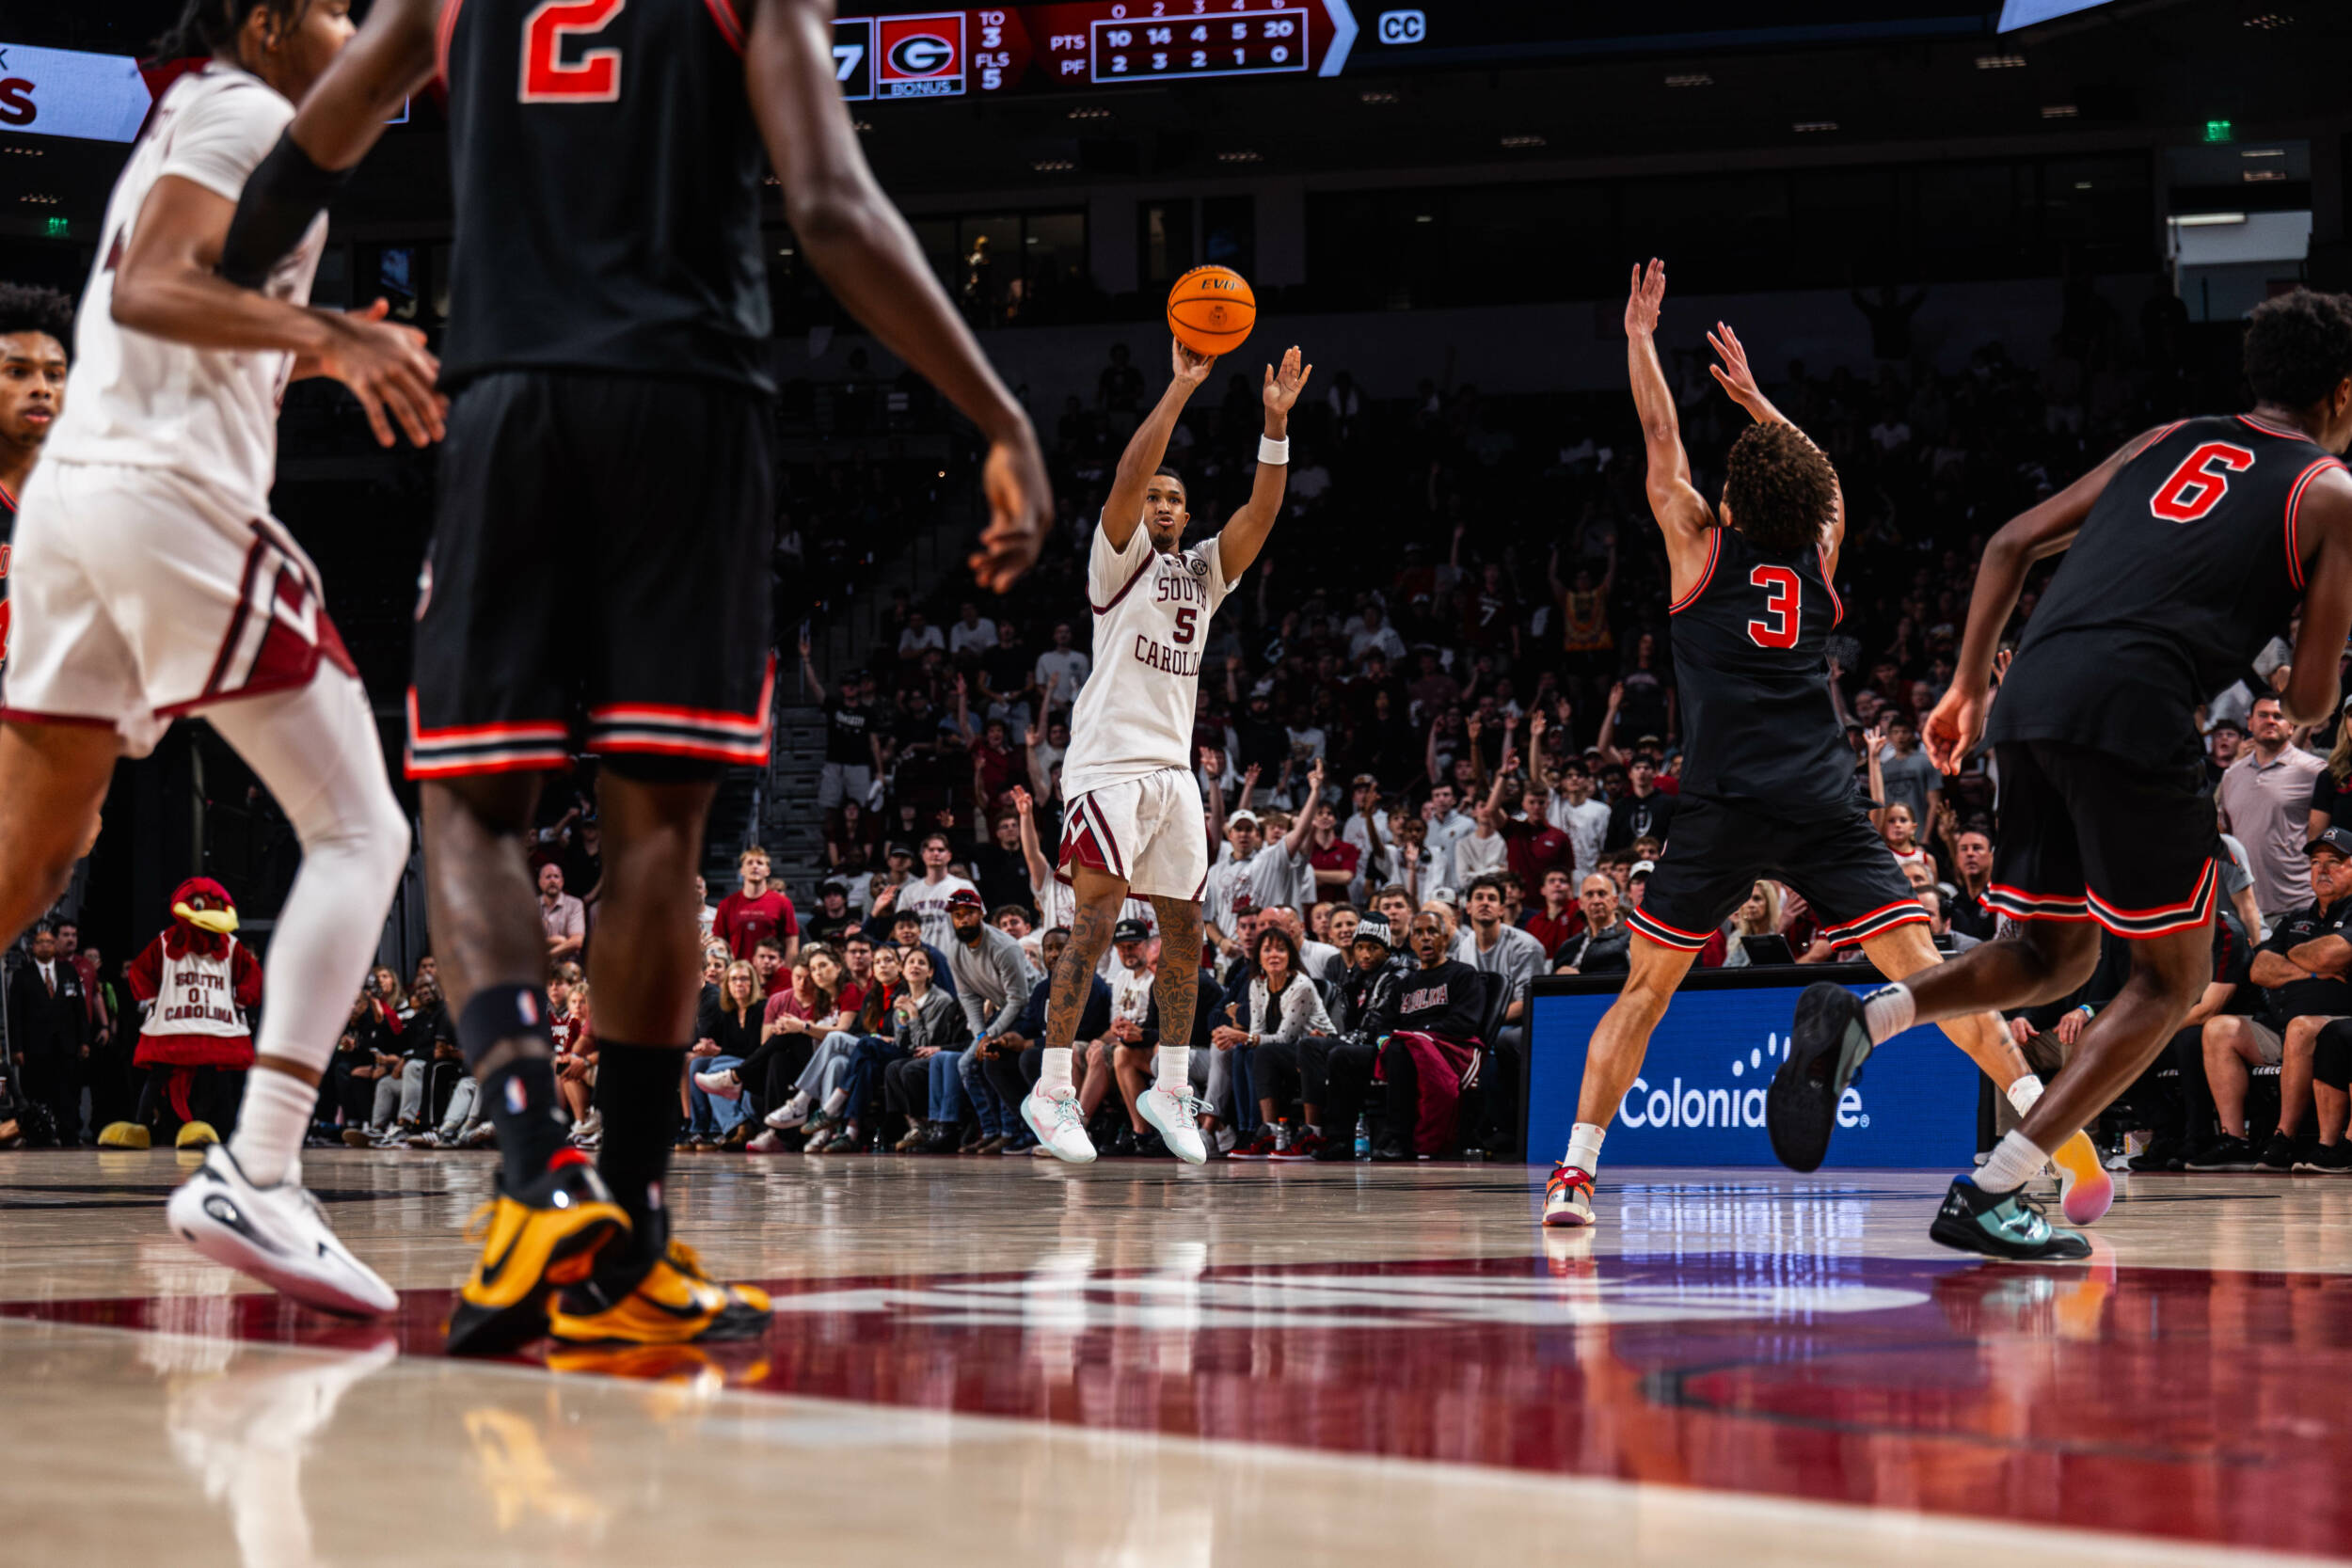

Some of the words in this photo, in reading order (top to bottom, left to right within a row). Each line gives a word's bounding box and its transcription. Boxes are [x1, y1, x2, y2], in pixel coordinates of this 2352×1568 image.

[977, 11, 1005, 25] TO
[1111, 4, 1126, 19] 0
[1151, 2, 1165, 17] 2
[1192, 0, 1205, 14] 3
[981, 26, 1001, 48] 3
[1050, 35, 1086, 52] PTS
[1107, 30, 1132, 47] 10
[1146, 27, 1173, 45] 14
[1191, 25, 1207, 42] 4
[1232, 24, 1248, 40] 5
[1263, 21, 1294, 38] 20
[1384, 16, 1424, 40] CC
[517, 0, 625, 103] 2
[833, 44, 864, 81] 7
[976, 52, 1009, 69] FLS
[1061, 60, 1086, 76] PF
[1112, 55, 1128, 72] 2
[1152, 53, 1168, 70] 3
[1191, 51, 1207, 68] 2
[1233, 48, 1246, 65] 1
[1271, 45, 1288, 63] 0
[892, 81, 952, 97] BONUS
[981, 69, 1001, 90] 5
[2150, 440, 2255, 524] 6
[1157, 576, 1207, 611] SOUTH
[1748, 564, 1802, 649] 3
[1173, 607, 1198, 644] 5
[175, 972, 225, 991] SOUTH
[1400, 983, 1449, 1015] AROLINA
[165, 1005, 234, 1025] CAROLINA
[1618, 1077, 1774, 1129] Colonia
